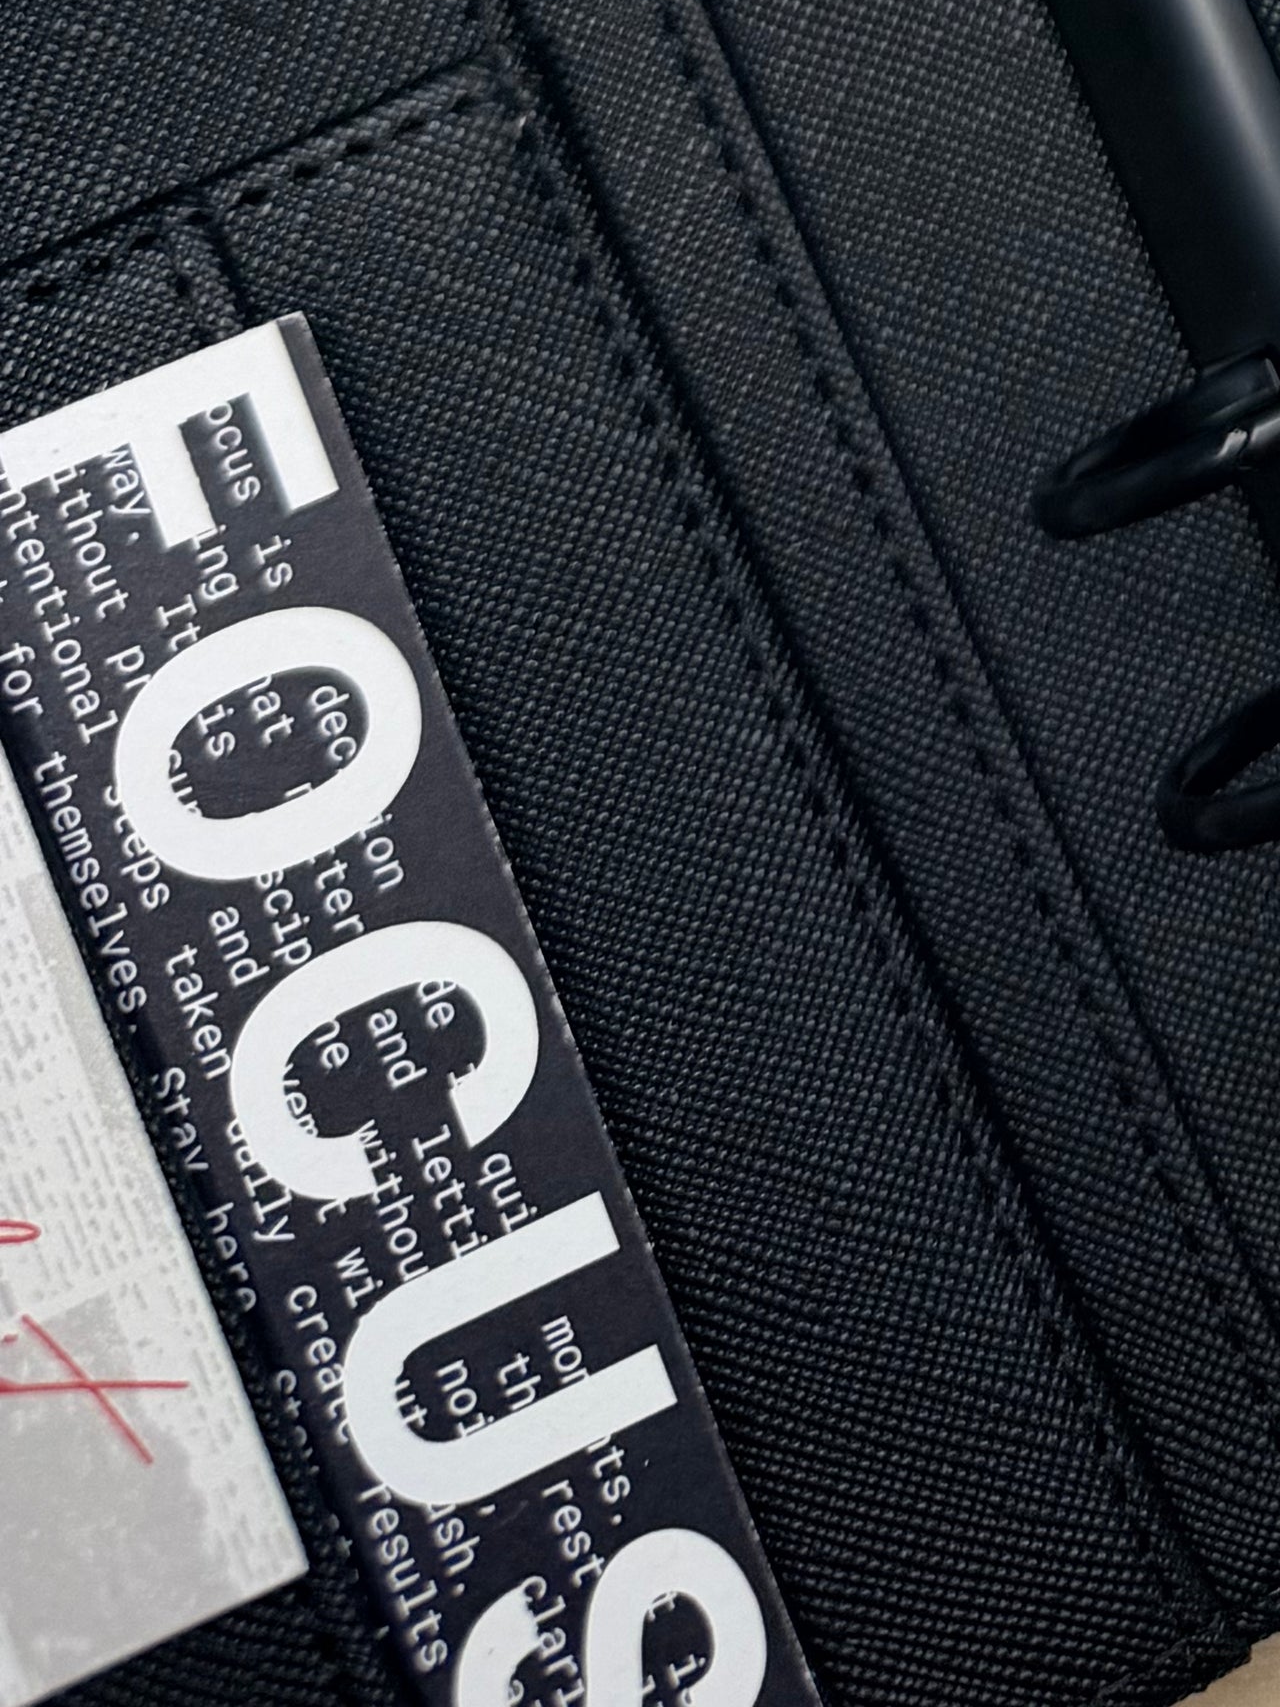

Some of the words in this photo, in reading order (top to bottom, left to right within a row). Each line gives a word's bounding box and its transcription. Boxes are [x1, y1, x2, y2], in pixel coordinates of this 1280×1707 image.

[0, 642, 43, 715] for
[34, 751, 147, 1032] themselves.
[0, 319, 766, 1707] FOCUS
[44, 468, 129, 621] ithout
[209, 907, 270, 987] and
[196, 704, 235, 760] is
[354, 1120, 428, 1282] withou
[200, 404, 261, 506] ocus
[252, 535, 293, 591] is
[479, 1153, 537, 1232] qui
[0, 474, 118, 745] ntentional
[166, 945, 231, 1079] taken
[360, 1483, 447, 1670] results
[368, 1009, 427, 1089] and
[412, 1124, 487, 1257] letti
[498, 1353, 540, 1410] th
[543, 1480, 604, 1586] rest
